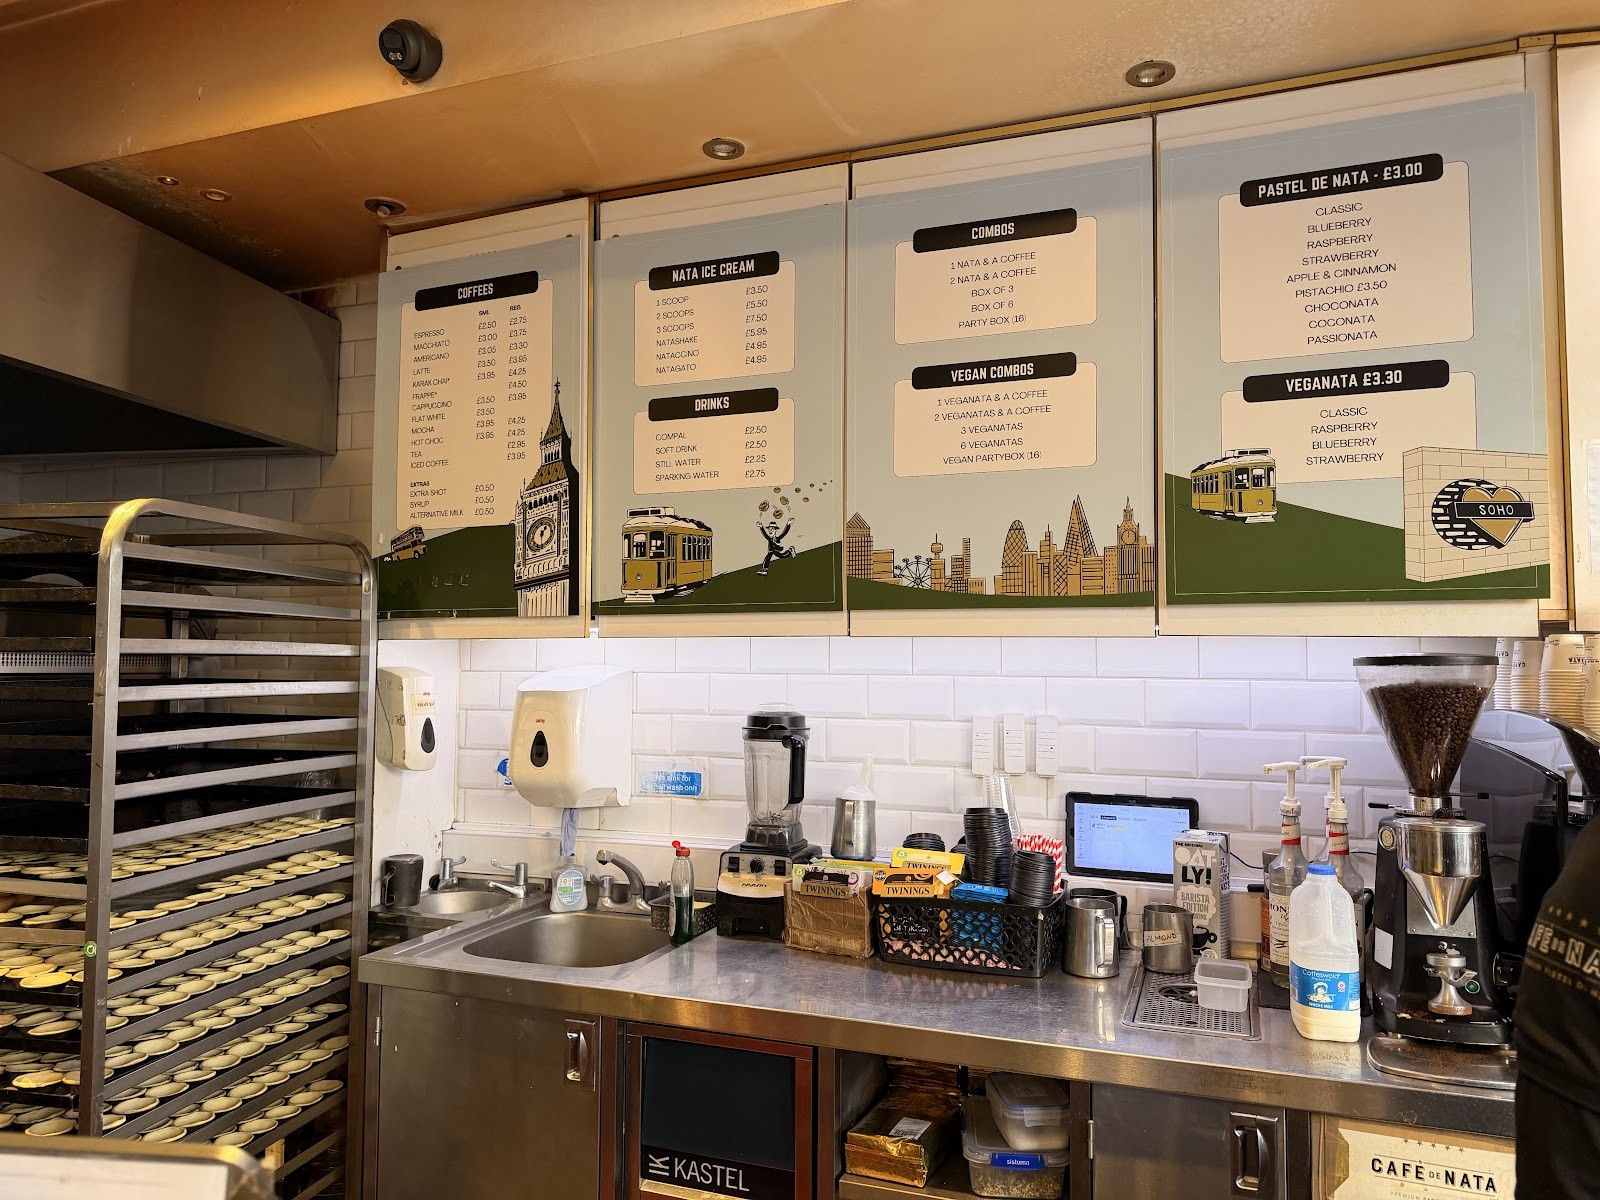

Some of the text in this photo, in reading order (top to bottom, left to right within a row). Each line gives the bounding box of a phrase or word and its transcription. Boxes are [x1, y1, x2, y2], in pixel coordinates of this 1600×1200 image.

[1257, 162, 1423, 199] PASTEL DE NATA £3.00
[1315, 202, 1363, 217] CLASSIC
[971, 222, 1015, 240] COMBOS
[1307, 218, 1372, 234] BLUEBERRY
[1306, 234, 1373, 250] RASPBERRY
[951, 262, 955, 270] 1
[957, 259, 980, 269] NATA
[983, 257, 989, 266] &
[1000, 251, 1036, 264] COFFEE
[1302, 249, 1379, 266] STRAWBERRY
[672, 259, 754, 282] NATA ICE CREAM
[950, 277, 955, 285] 2
[957, 275, 981, 284] NATA
[983, 273, 990, 281] &
[1000, 267, 1037, 279] COFFEE
[1286, 263, 1397, 284] APPLE & CINNAMON
[458, 283, 494, 299] COFFEES
[662, 296, 689, 306] SCOOP
[746, 284, 768, 295] £3.50
[971, 285, 1014, 298] BOX OF 3
[1295, 281, 1388, 298] PISTACHIO £3.50
[510, 304, 521, 312] REG
[656, 299, 768, 320] 2 SCOOPS £5.50
[971, 300, 1014, 313] BOX OF 6
[1304, 298, 1379, 314] CHOCONATA
[414, 316, 527, 339] ESPRESSO £2.50 £2.75
[663, 323, 695, 332] SCOOPS
[746, 314, 767, 324] £7.50
[958, 314, 1026, 329] PARTY BOX (16)
[1308, 315, 1375, 329] COCONATA
[414, 328, 527, 351] MACCHIATO £3.00 £3.75
[656, 328, 767, 347] NATASHAKE £5.95
[1307, 331, 1378, 345] PASSIONATA
[413, 341, 528, 363] AMERICANO £3.05 £3.30
[656, 341, 767, 360] NATACCINO £4.95
[413, 355, 528, 376] LATTE £3.50 £3.95
[656, 355, 767, 374] NATAGATO £4.95
[951, 362, 1034, 382] VEGAN COMBOS
[413, 368, 527, 388] KARAK £3.95 £4.25
[508, 380, 527, 389] £4.50
[1286, 370, 1403, 393] VEGANATA £3.30
[412, 392, 527, 411] CAPPUCCINO £3.50 £3.95
[695, 396, 730, 412] DRINKS
[944, 395, 992, 406] VEGANATA
[1012, 389, 1048, 400] COFFEE
[412, 408, 495, 422] FLAT WHITE £3.50
[934, 413, 939, 421] 2
[942, 409, 996, 421] VEGANATAS
[1006, 408, 1013, 416] A
[1015, 405, 1052, 415] COFFEE
[1319, 407, 1368, 418] CLASSIC
[411, 416, 526, 434] MOCHA £3.95 £4.25
[960, 422, 1024, 434] 3 VEGANATAS
[1310, 422, 1378, 435] RASPBERRY
[411, 428, 526, 446] HOT CHOC £3.95 £4.25
[655, 426, 767, 441] COMPAL £2.50
[411, 440, 526, 458] TEA £2.95
[655, 440, 767, 455] SOFT DRINK £2.50
[960, 438, 1024, 450] 6 VEGANATAS
[1312, 438, 1377, 450] BLUEBERRY
[410, 452, 526, 469] ICED COFFEE £3.95
[655, 455, 766, 468] STILL WATER £2.25
[943, 451, 1042, 465] VEGAN PARTYBOX (16)
[1306, 453, 1385, 466] STRAWBERRY
[655, 470, 766, 482] SPARKING WATER £2.75
[410, 484, 494, 498] EXTRA SHOT £0.50
[410, 496, 494, 508] SYRUP £0.50
[1478, 504, 1514, 516] SOHO
[410, 507, 494, 519] ALTERNATIVE MILK £0.50
[1182, 866, 1211, 885] LY!
[806, 884, 846, 896] TWININGS
[886, 886, 930, 895] TWININGS
[1181, 892, 1210, 903] BARISTA
[1183, 902, 1208, 913] EDITION
[1147, 932, 1177, 942] ALMOND
[1303, 969, 1339, 979] Cotteswold
[675, 1158, 750, 1191] KASTEL
[1372, 1158, 1497, 1193] CAFÉ DE NATA
